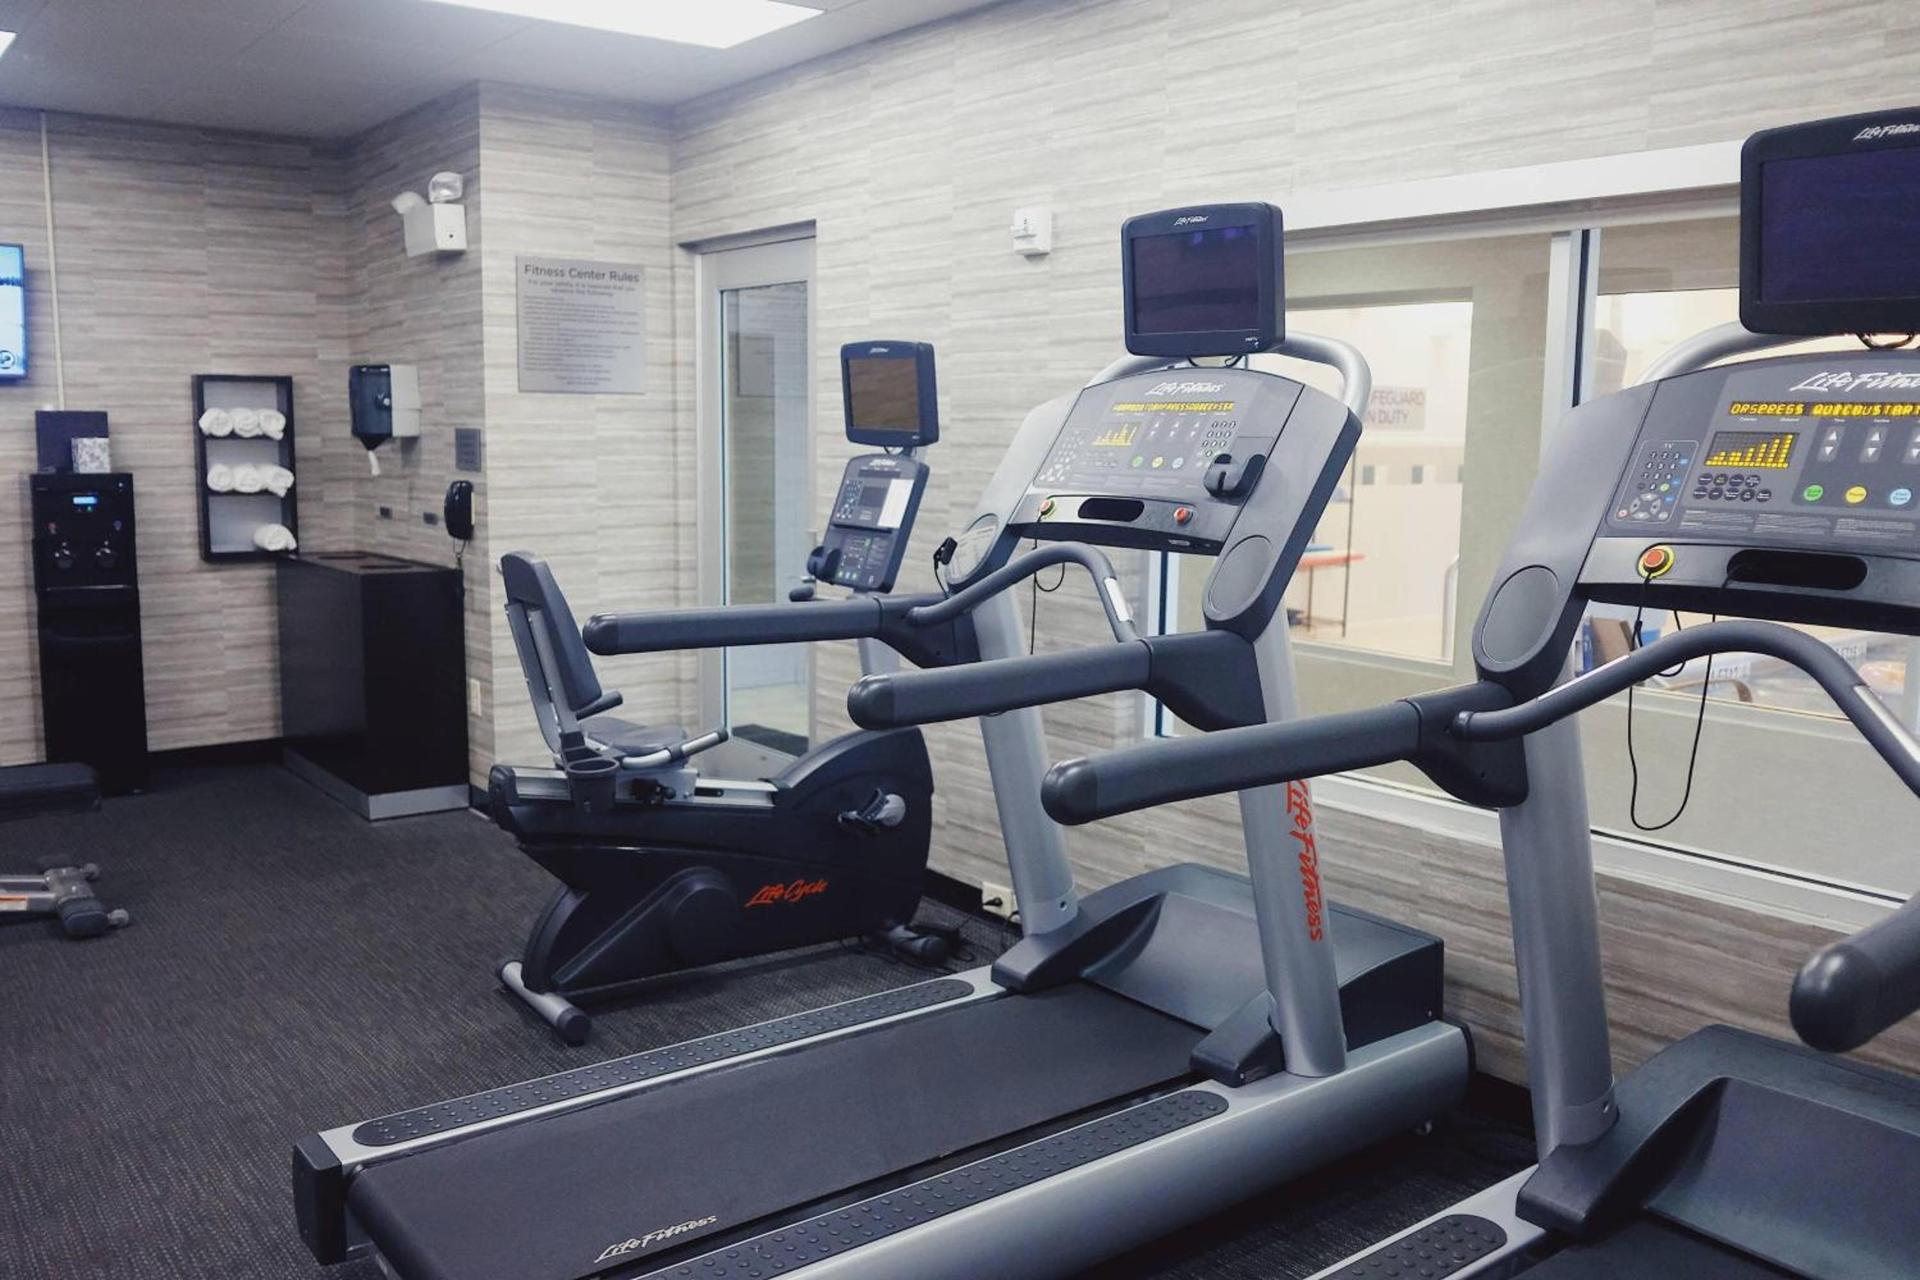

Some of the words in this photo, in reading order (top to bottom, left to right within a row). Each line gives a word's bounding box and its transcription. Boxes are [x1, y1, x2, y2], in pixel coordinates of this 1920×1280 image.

[524, 264, 566, 278] Fitness
[568, 267, 606, 281] Center
[609, 270, 640, 283] Rules
[1371, 389, 1425, 406] FEGUARD
